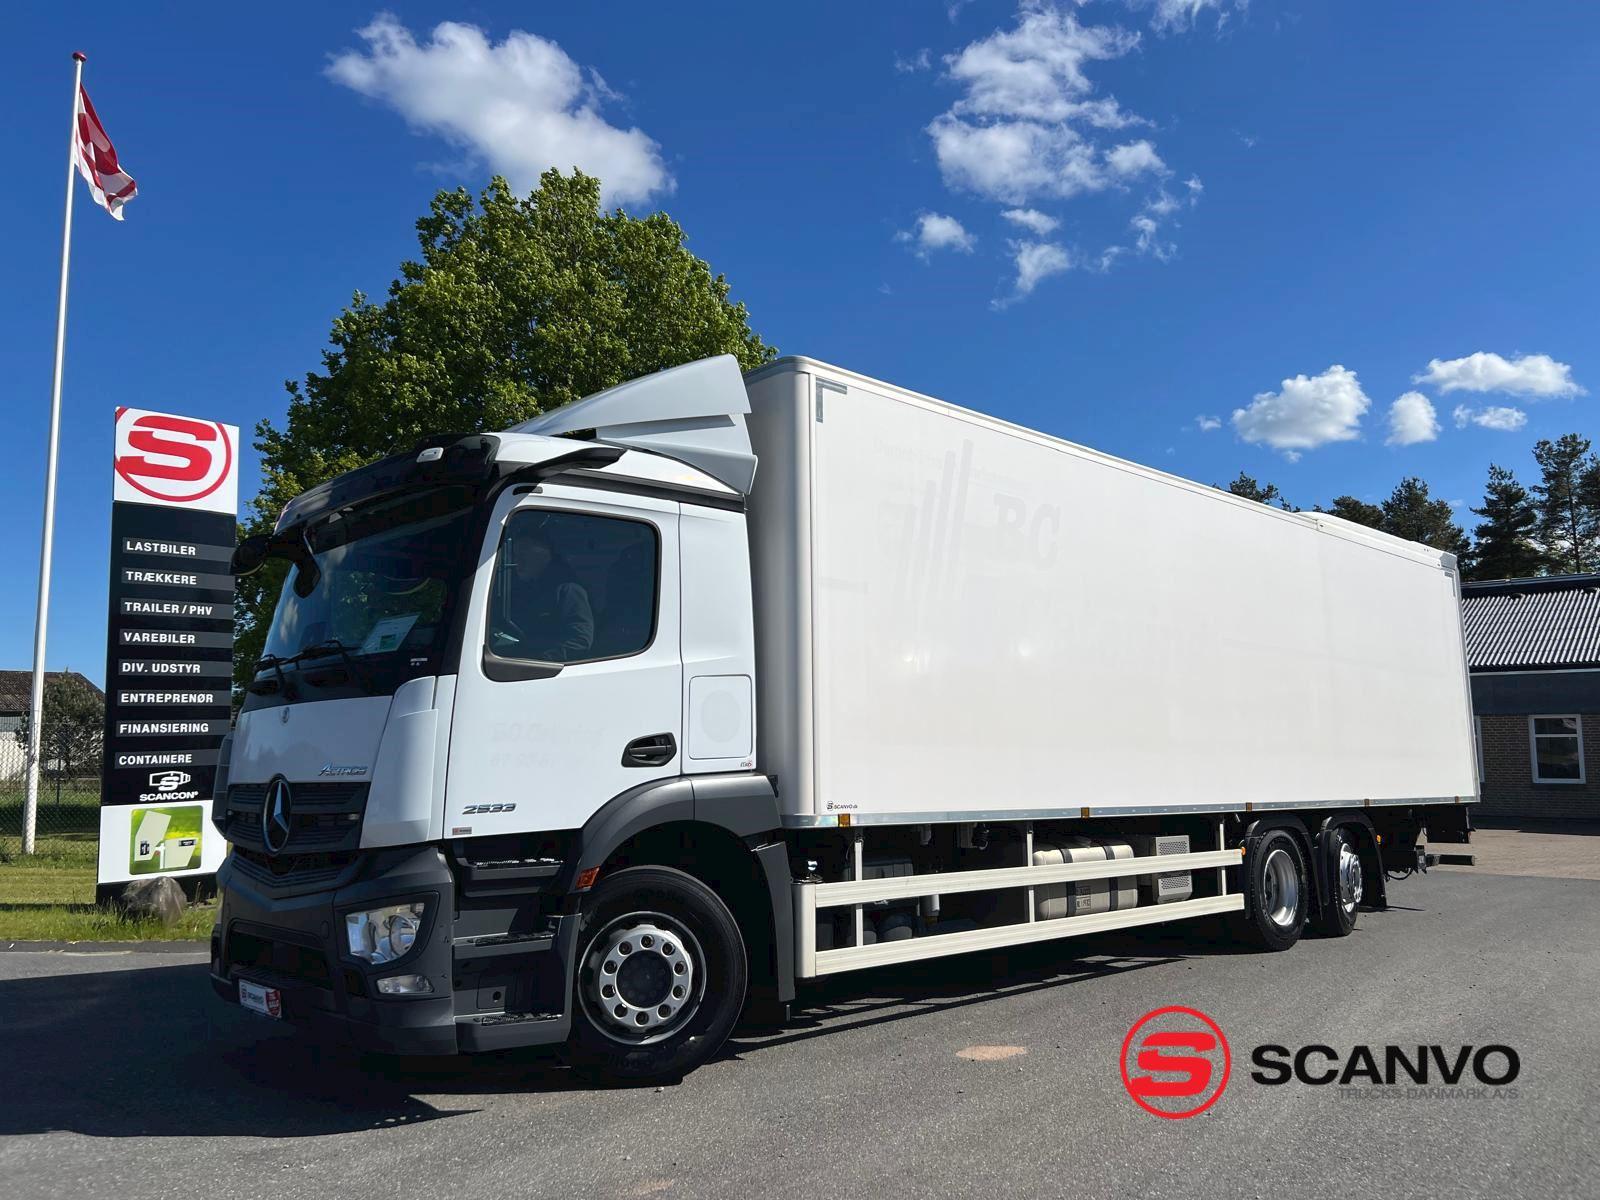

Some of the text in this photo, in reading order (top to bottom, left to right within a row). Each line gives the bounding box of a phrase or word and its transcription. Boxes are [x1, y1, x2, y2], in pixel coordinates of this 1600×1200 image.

[126, 541, 196, 556] LASTBILER
[126, 571, 197, 585] TRÆKKERE
[125, 602, 180, 614] TRAILER
[189, 606, 213, 616] PHV
[124, 632, 195, 644] VAREBILER
[122, 663, 201, 674] DIV. UDSTYR
[121, 693, 214, 703] ENTREPRENØR
[119, 723, 209, 734] FINANSIERING
[119, 754, 193, 766] CONTAINERE
[463, 803, 516, 815] 2533
